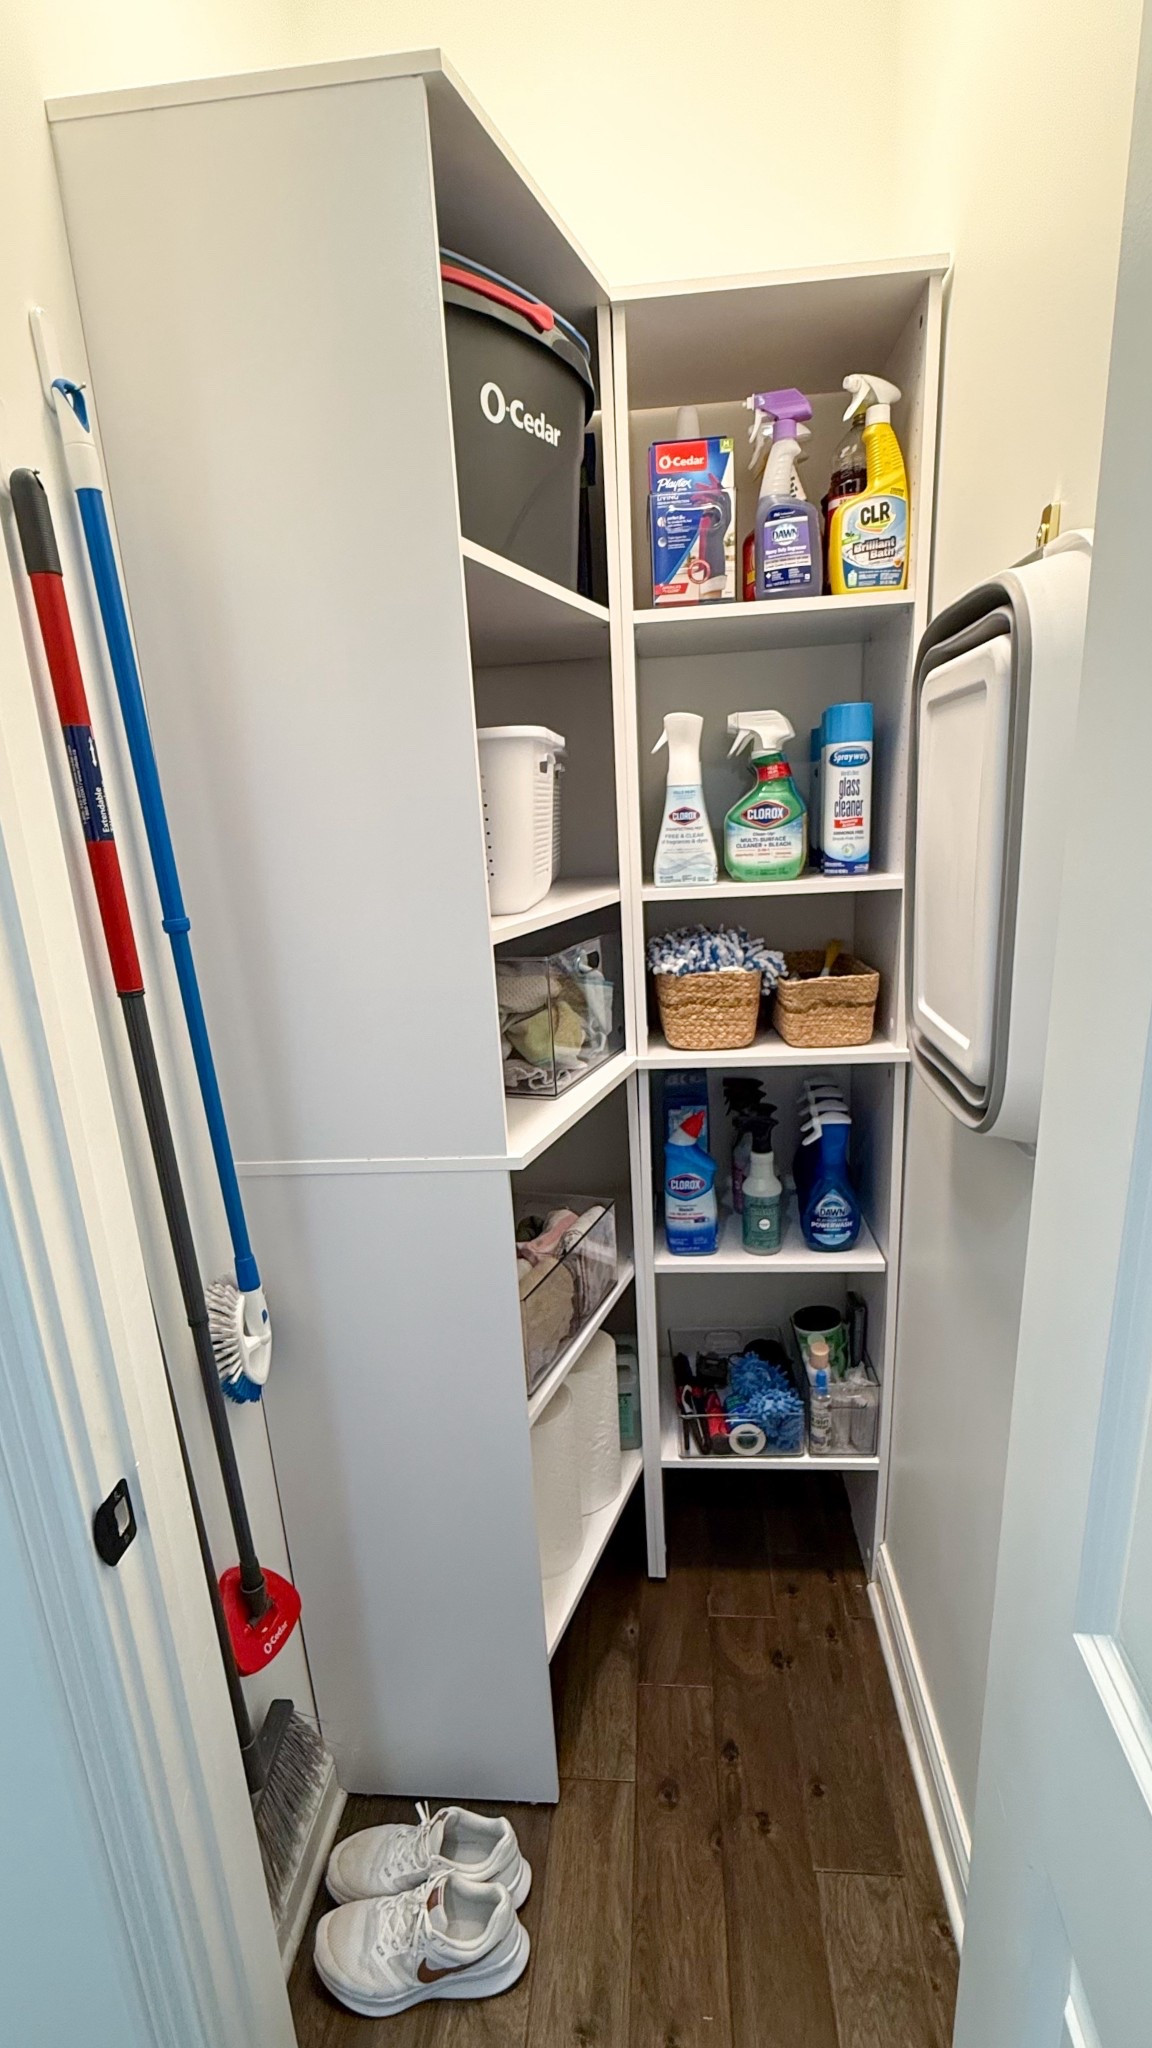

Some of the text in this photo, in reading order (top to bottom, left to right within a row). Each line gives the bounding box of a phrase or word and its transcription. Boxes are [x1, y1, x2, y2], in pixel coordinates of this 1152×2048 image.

[480, 382, 561, 447] O-Cedar
[659, 455, 705, 469] O-Cedar
[657, 477, 692, 492] Playtex
[860, 501, 890, 526] CLR
[772, 528, 798, 540] DAWN
[853, 536, 896, 554] Brilliant
[869, 548, 895, 560] Bath
[833, 751, 868, 764] Sprayway
[838, 777, 860, 799] glass
[95, 786, 110, 833] Extendable
[746, 807, 784, 820] CLOROX
[834, 799, 864, 818] cleaner
[672, 811, 698, 821] CLOROX
[670, 1179, 701, 1190] CLOROX
[820, 1207, 846, 1217] DAWN
[810, 1220, 853, 1229] POWERWASH
[264, 1621, 288, 1654] O-Cedar
